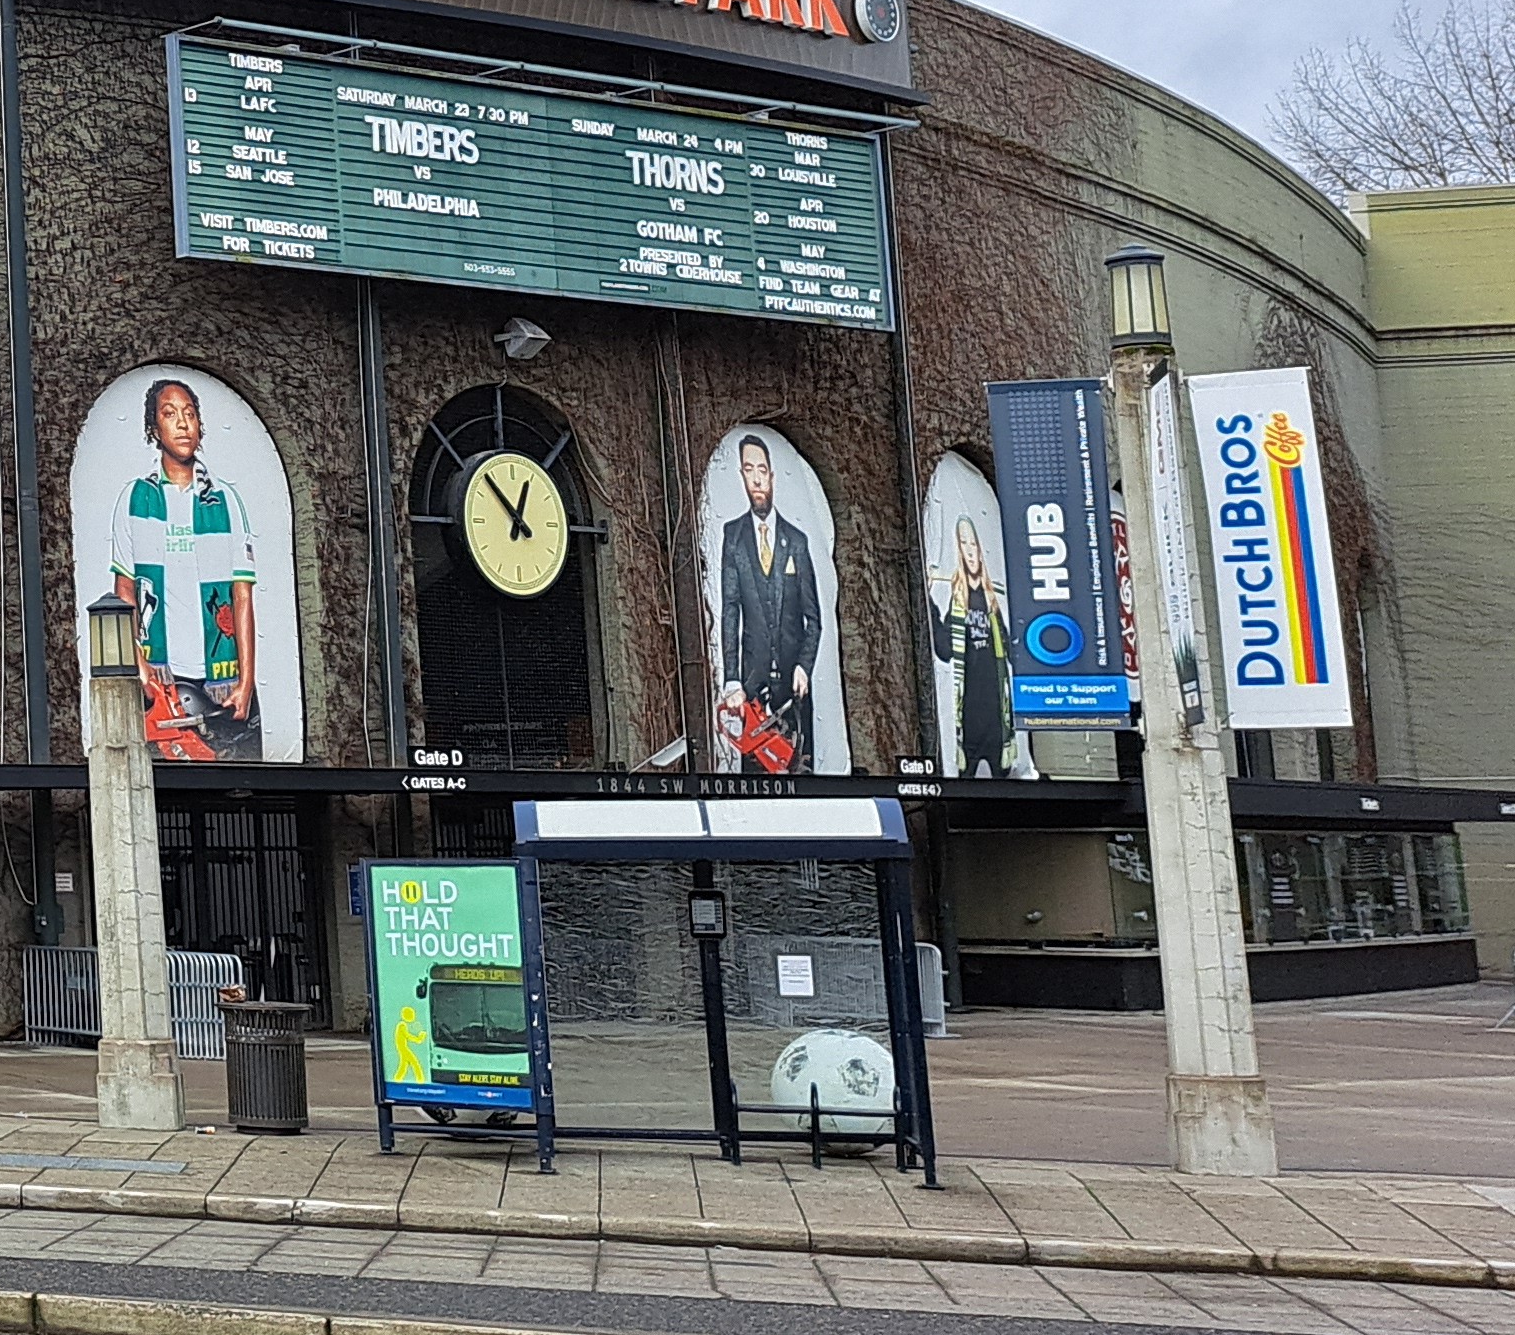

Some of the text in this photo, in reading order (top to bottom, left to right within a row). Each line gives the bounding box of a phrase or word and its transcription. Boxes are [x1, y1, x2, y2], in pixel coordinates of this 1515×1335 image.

[228, 53, 283, 74] TIMBERS
[244, 76, 273, 93] APR
[184, 87, 277, 113] 13 LAFC
[336, 86, 397, 107] SATURDAY
[404, 95, 448, 114] MARCH
[454, 102, 470, 117] 23
[509, 110, 529, 126] PM
[244, 125, 275, 142] MAY
[363, 114, 480, 165] TIMBERS
[571, 118, 615, 137] SUNDAY
[636, 127, 678, 146] MARCH
[683, 134, 699, 148] 24
[724, 139, 743, 155] PM
[784, 131, 828, 150] THORNS
[186, 139, 288, 165] 12 SEATTLE
[793, 151, 821, 167] MAR
[188, 159, 295, 186] 15 SAN JOSE
[413, 164, 432, 180] VS
[624, 149, 726, 195] THORNS
[749, 164, 836, 188] 30 LOUISVILLE
[373, 187, 481, 218] PHILADELPHIA
[668, 196, 686, 212] VS
[799, 197, 824, 213] APR
[200, 212, 328, 240] VISIT TIMBERS.COM
[753, 210, 837, 233] 20 HOUSTON
[636, 219, 724, 246] GOTHAM FC
[222, 235, 315, 259] FOR TICKETS
[639, 246, 724, 269] PRESENTED BY
[800, 243, 826, 259] MAY
[675, 264, 743, 285] CIDERHOUSE
[779, 259, 846, 280] WASHINGTON
[758, 275, 882, 303] FIND TEAM GEAR AT
[764, 295, 876, 320] PTFCAUTHENTICS.COM
[1263, 412, 1306, 465] Coffee
[1027, 502, 1071, 602] HUB
[1215, 413, 1286, 686] DUTCH BROS
[1097, 647, 1108, 666] Risk
[212, 659, 239, 680] PTF
[1019, 683, 1118, 695] Proud to Support
[1044, 695, 1098, 705] our Team
[1023, 717, 1122, 726] hubinternational.com
[414, 749, 449, 766] Gate
[451, 749, 463, 766] D
[900, 758, 934, 774] Gate D
[410, 776, 467, 790] GATES A-C
[596, 777, 797, 796] 1844 SW MORRISON
[898, 783, 922, 795] GATES
[383, 906, 453, 931] THAT
[385, 932, 514, 959] THOUGHT
[454, 968, 486, 980] HEADS
